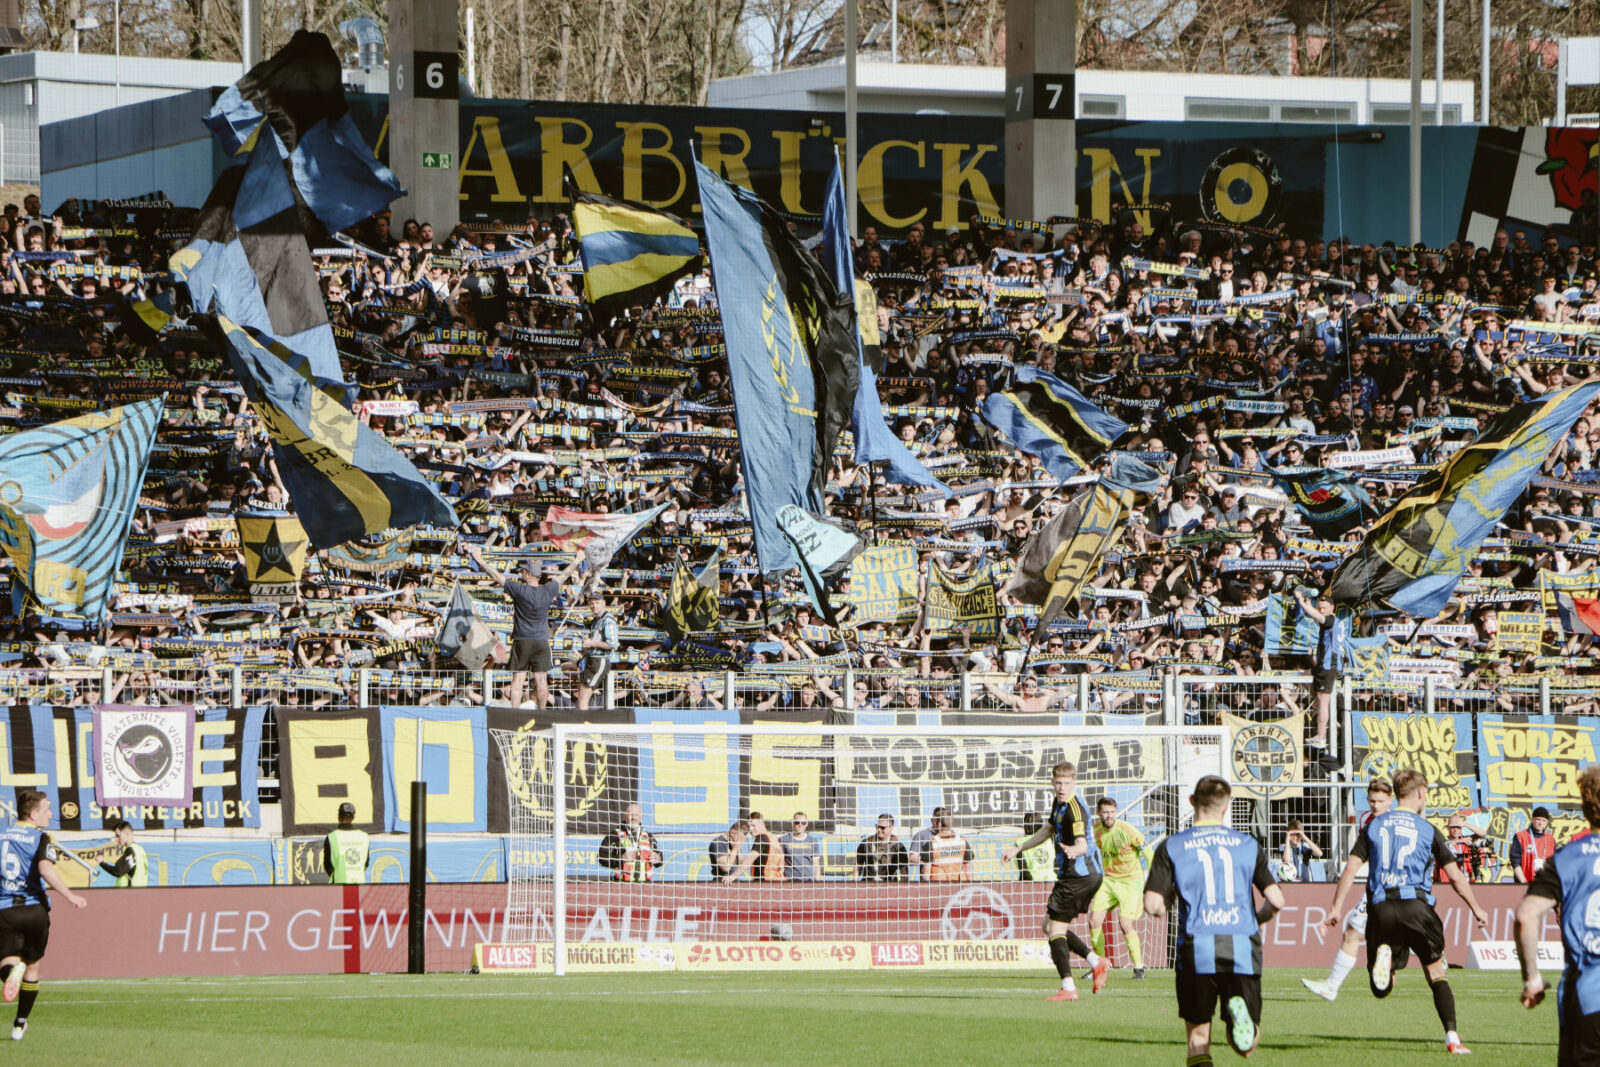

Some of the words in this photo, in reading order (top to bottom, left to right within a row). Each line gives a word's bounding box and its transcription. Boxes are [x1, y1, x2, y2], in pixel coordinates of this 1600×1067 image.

[426, 62, 444, 89] 6
[1046, 84, 1063, 110] 7
[374, 116, 1161, 236] ARBRÜCKN
[529, 335, 580, 347] SAARBRÜCKEN
[108, 381, 184, 390] LUDWIGSPARK
[912, 380, 929, 389] FC
[852, 549, 915, 574] NORD
[851, 568, 919, 603] SAAR
[1384, 624, 1467, 634] OSTFANKREICH
[152, 637, 241, 652] Saarbrücken
[1361, 714, 1457, 753] YOUNG
[103, 751, 116, 777] 2007
[168, 726, 186, 780] VIOLETTE
[849, 736, 1146, 781] NORDSAAR
[1234, 750, 1260, 765] PER
[115, 778, 171, 797] SALZBURG
[90, 801, 253, 819] SARREBRUCK
[1184, 834, 1242, 850] MULTHAUP
[1379, 826, 1419, 870] 17
[2, 840, 21, 881] 6
[509, 844, 601, 867] GIOVENT
[1197, 845, 1235, 905] 11
[158, 910, 271, 953] HIER
[286, 908, 556, 952] GEWNNEN
[487, 946, 533, 967] ALLES
[541, 948, 555, 966] IS
[567, 944, 635, 965] MÖGLICH!
[716, 945, 783, 962] LOTTO
[788, 945, 802, 962] 6
[830, 945, 856, 962] 49
[877, 944, 919, 963] ALLES
[929, 946, 950, 962] IST
[953, 941, 1018, 962] MÖGLICH!
[1480, 948, 1507, 961] INS
[1512, 948, 1561, 961] SEL.
